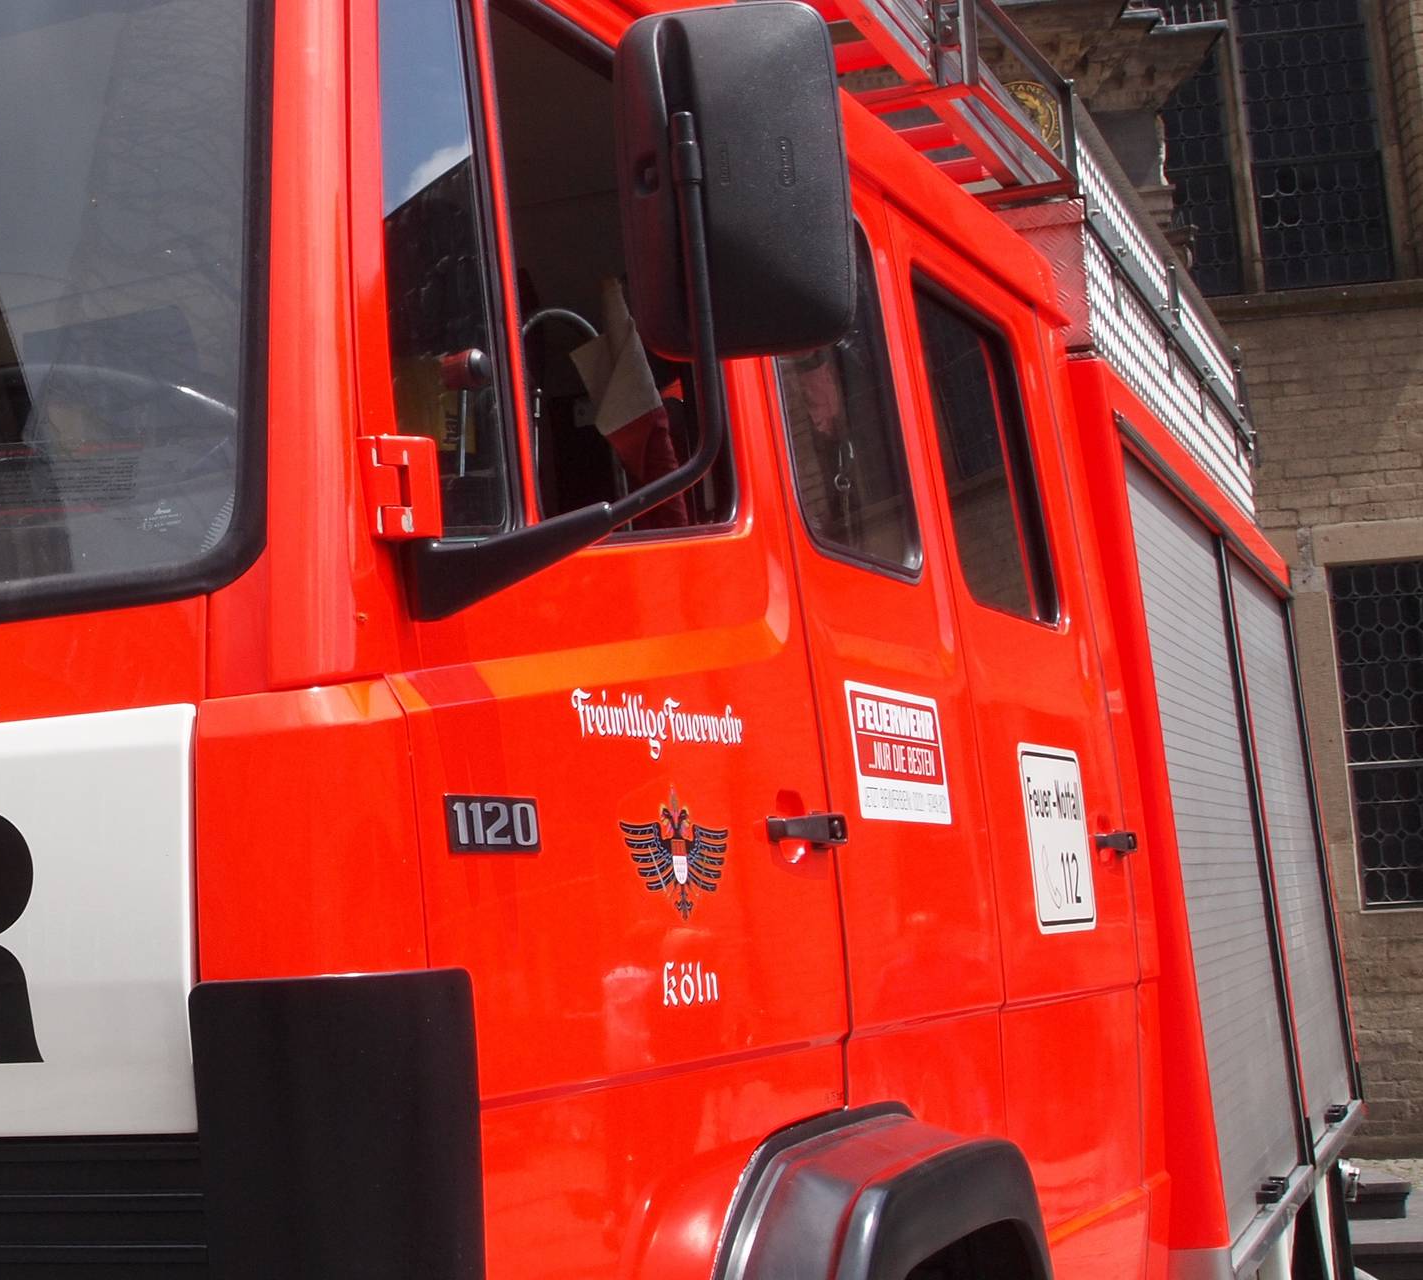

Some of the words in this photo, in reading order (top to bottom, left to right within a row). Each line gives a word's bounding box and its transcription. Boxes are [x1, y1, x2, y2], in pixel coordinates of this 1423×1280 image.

[571, 687, 668, 760] Freiwillige
[663, 697, 743, 745] Feuerwehr
[855, 697, 936, 740] FEUERWEHR
[891, 744, 907, 773] DIE
[906, 746, 936, 777] BESTEN
[453, 802, 538, 846] 1120
[1061, 852, 1081, 904] 112
